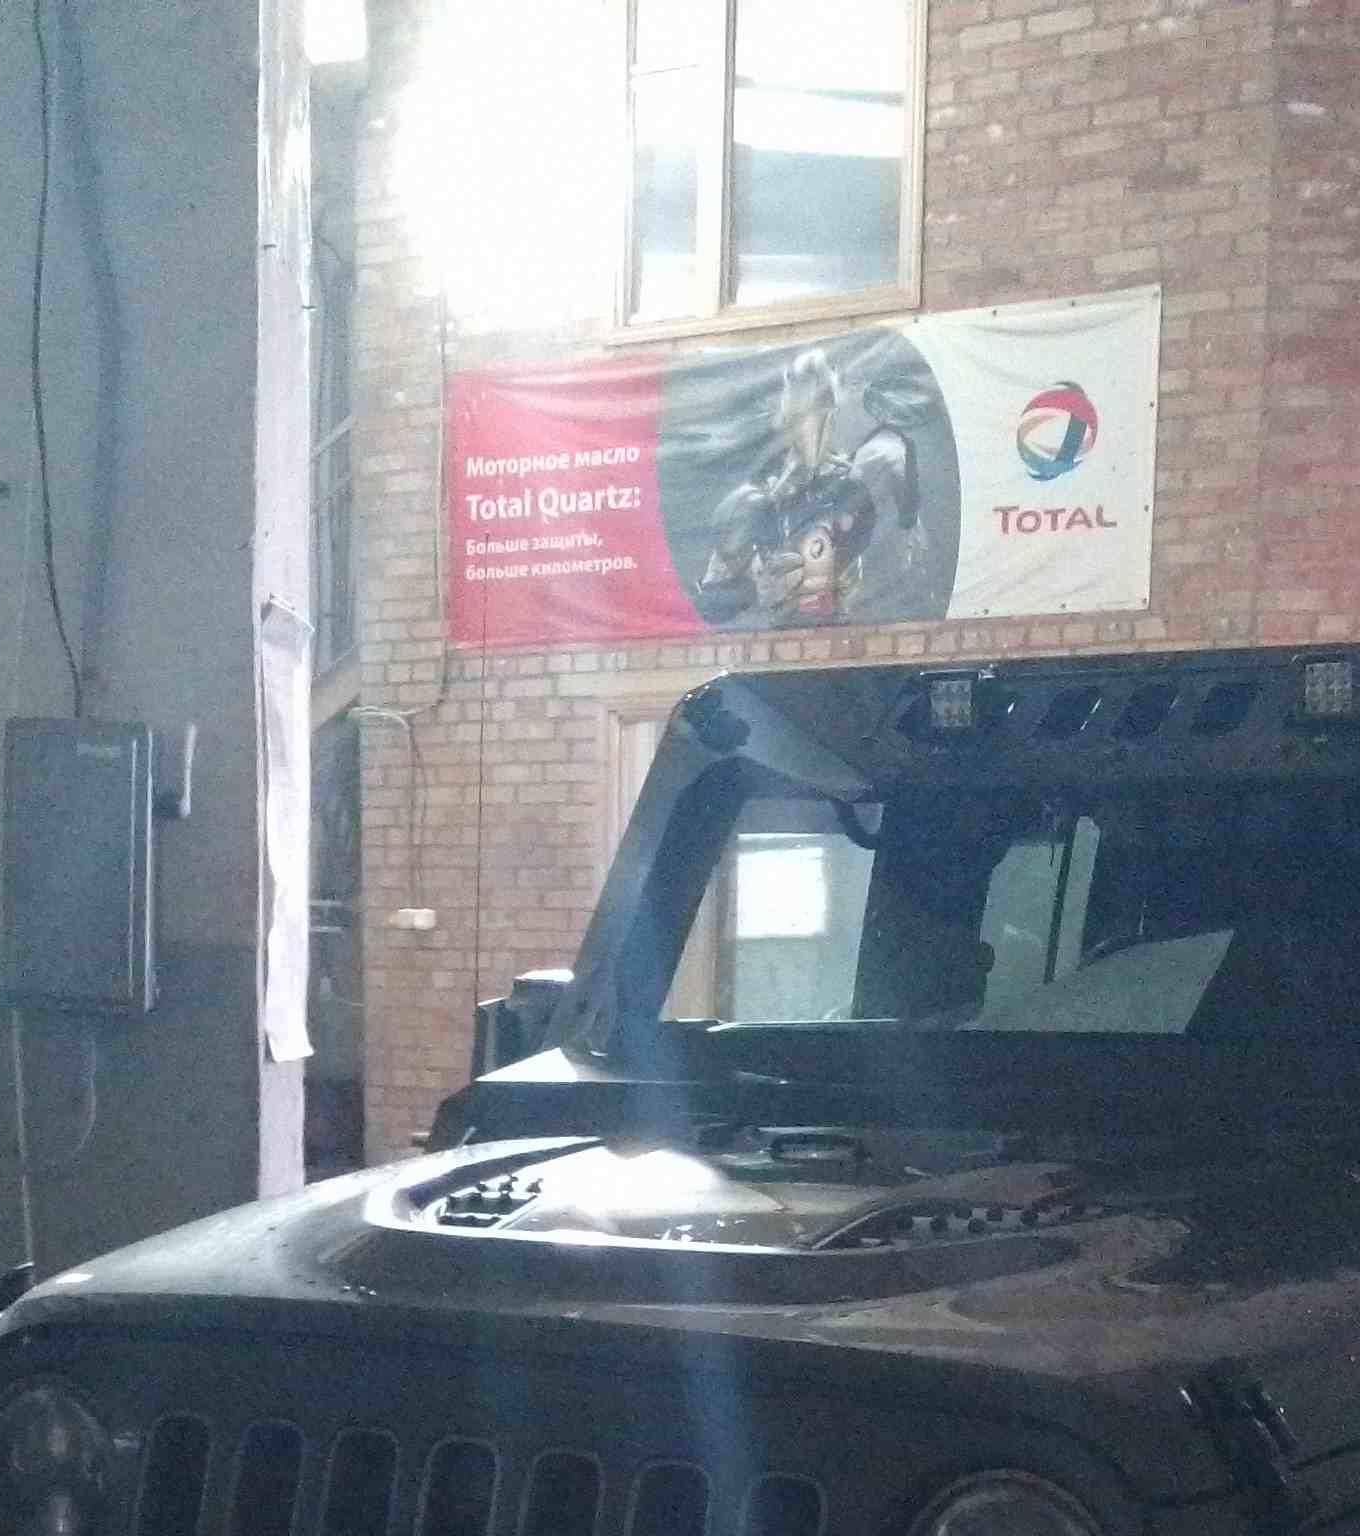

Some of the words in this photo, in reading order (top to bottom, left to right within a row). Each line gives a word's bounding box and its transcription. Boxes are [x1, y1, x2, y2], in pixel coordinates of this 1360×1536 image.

[465, 452, 570, 478] Моторное
[575, 446, 641, 469] масло
[465, 487, 532, 521] Total
[992, 503, 1118, 536] TOTAL
[465, 537, 529, 556] Больше
[532, 531, 603, 551] защиты,
[465, 562, 529, 581] больше
[531, 556, 638, 576] километров.
